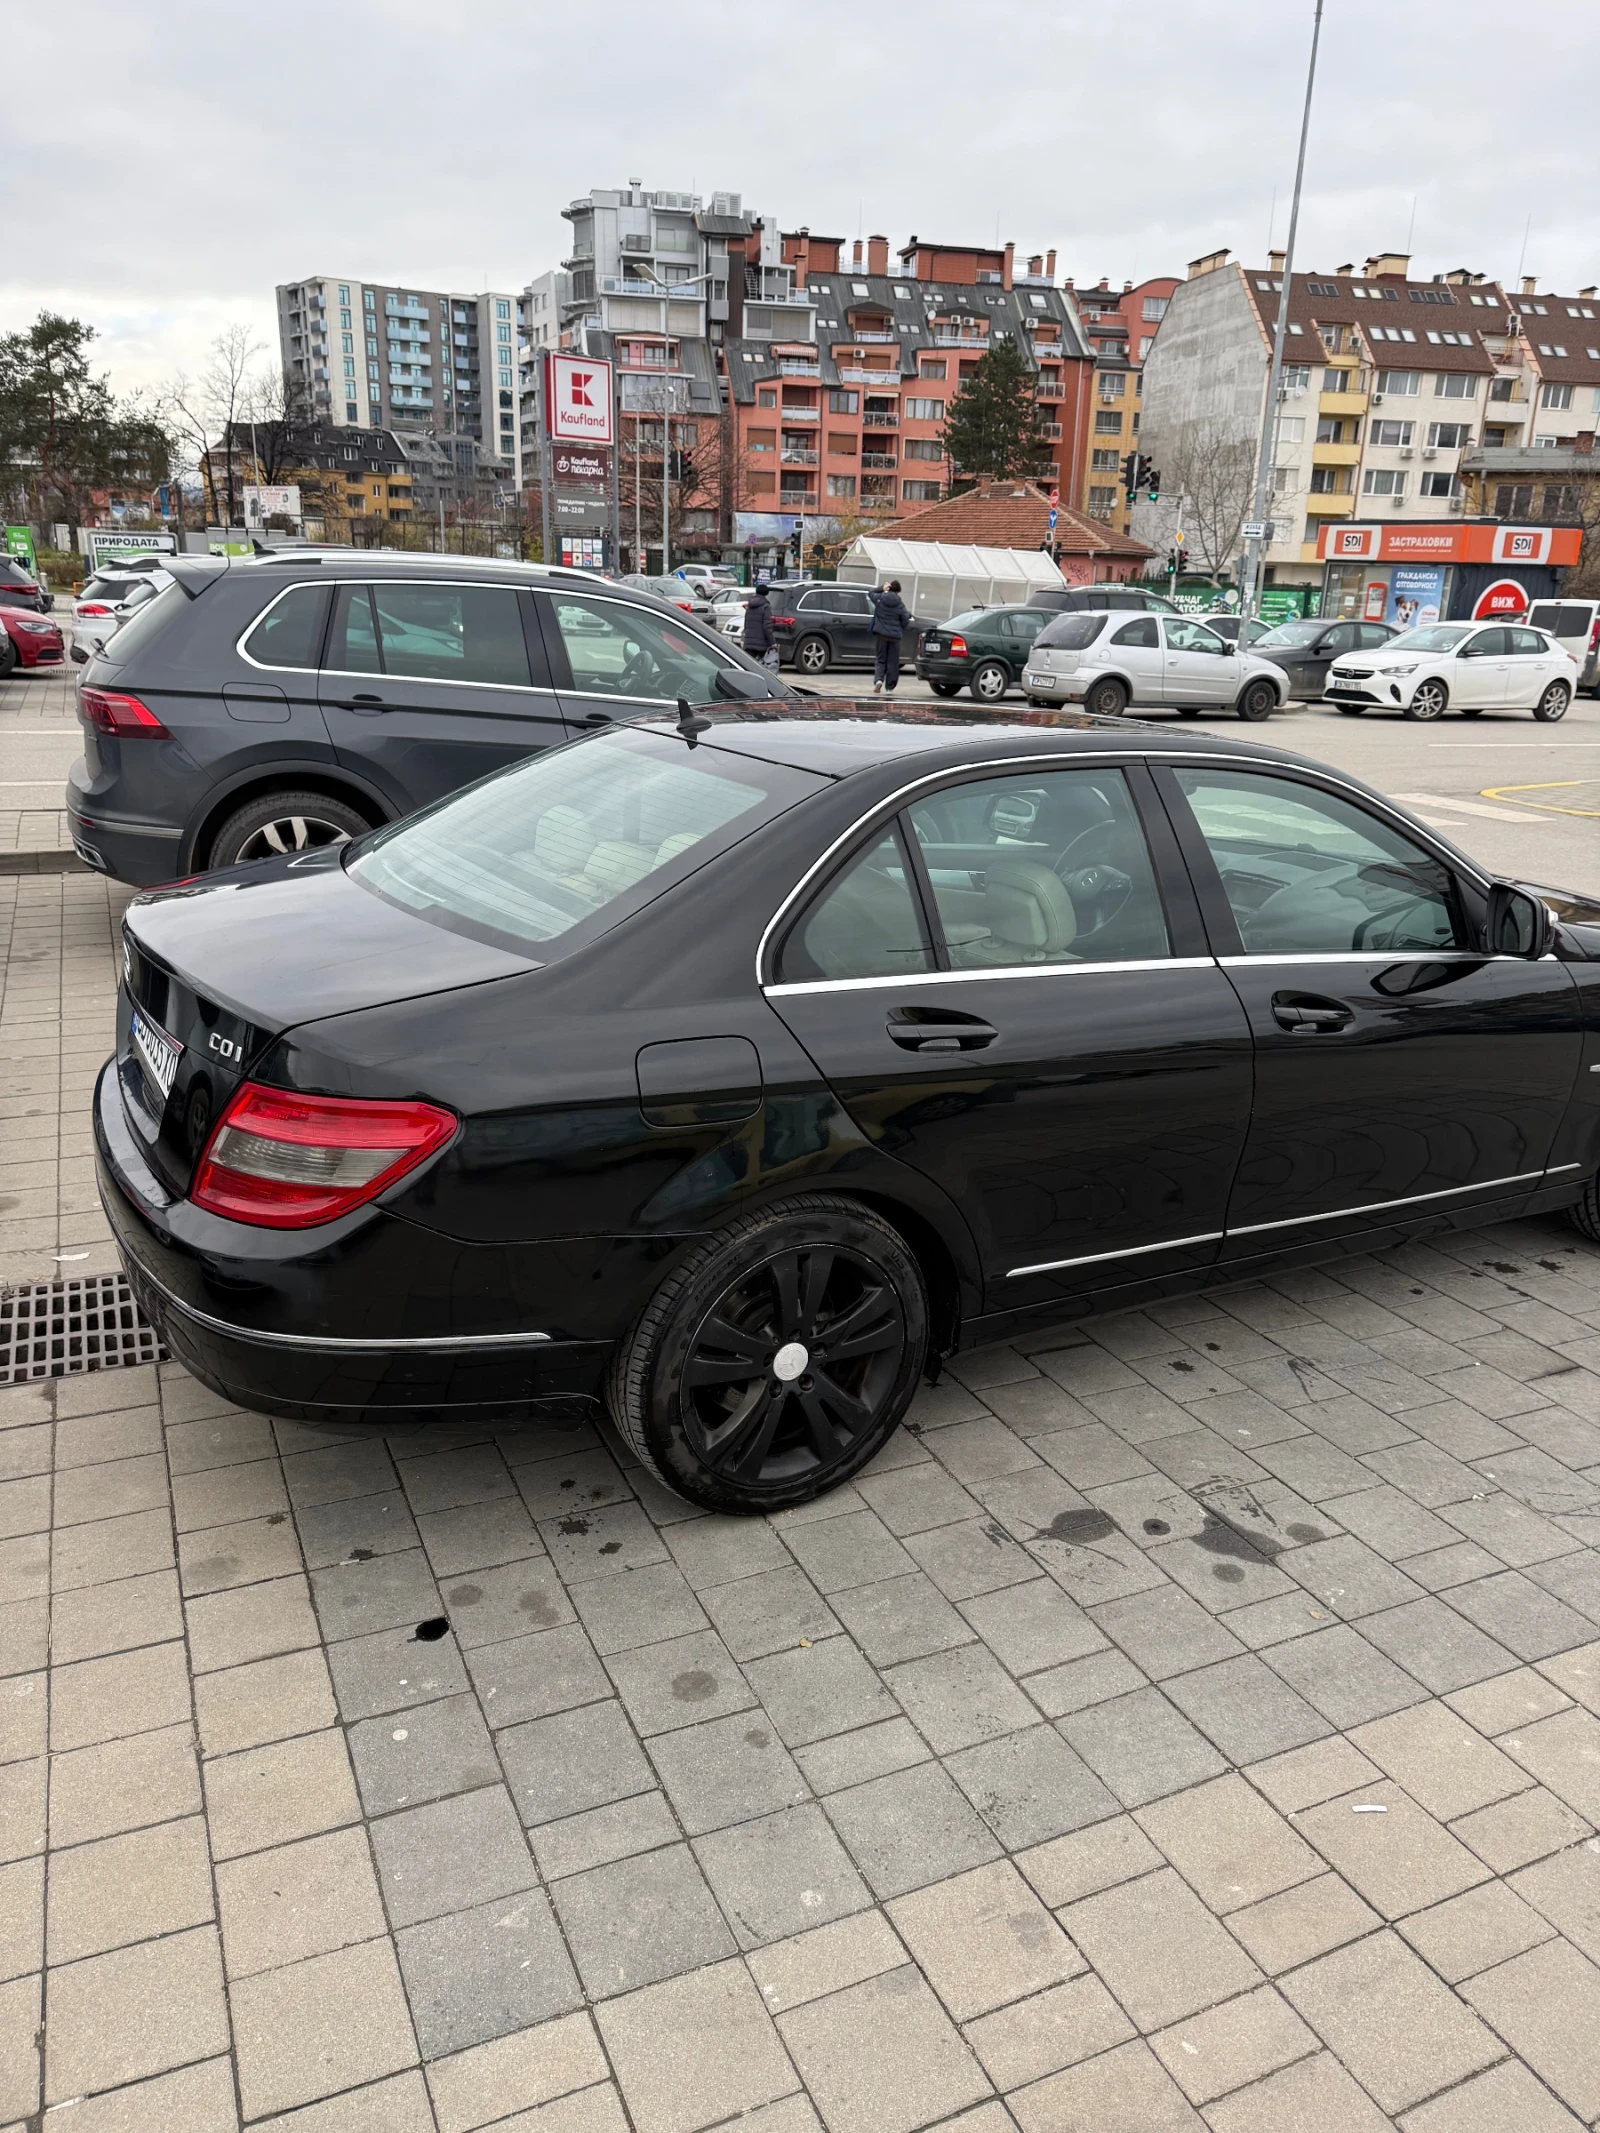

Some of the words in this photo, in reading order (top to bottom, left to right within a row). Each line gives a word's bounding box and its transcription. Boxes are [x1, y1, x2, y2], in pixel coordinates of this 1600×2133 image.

[560, 410, 605, 427] Kaufland
[570, 456, 599, 466] Kaufland
[94, 537, 160, 548] ПРИРОДАТА
[1344, 535, 1362, 547] SDI
[1388, 536, 1453, 547] ЗАСТРАХОВКИ
[1513, 538, 1532, 550] SDI
[1396, 571, 1439, 580] ГРАЖДАНСКА
[1491, 596, 1516, 608] ВИЖ
